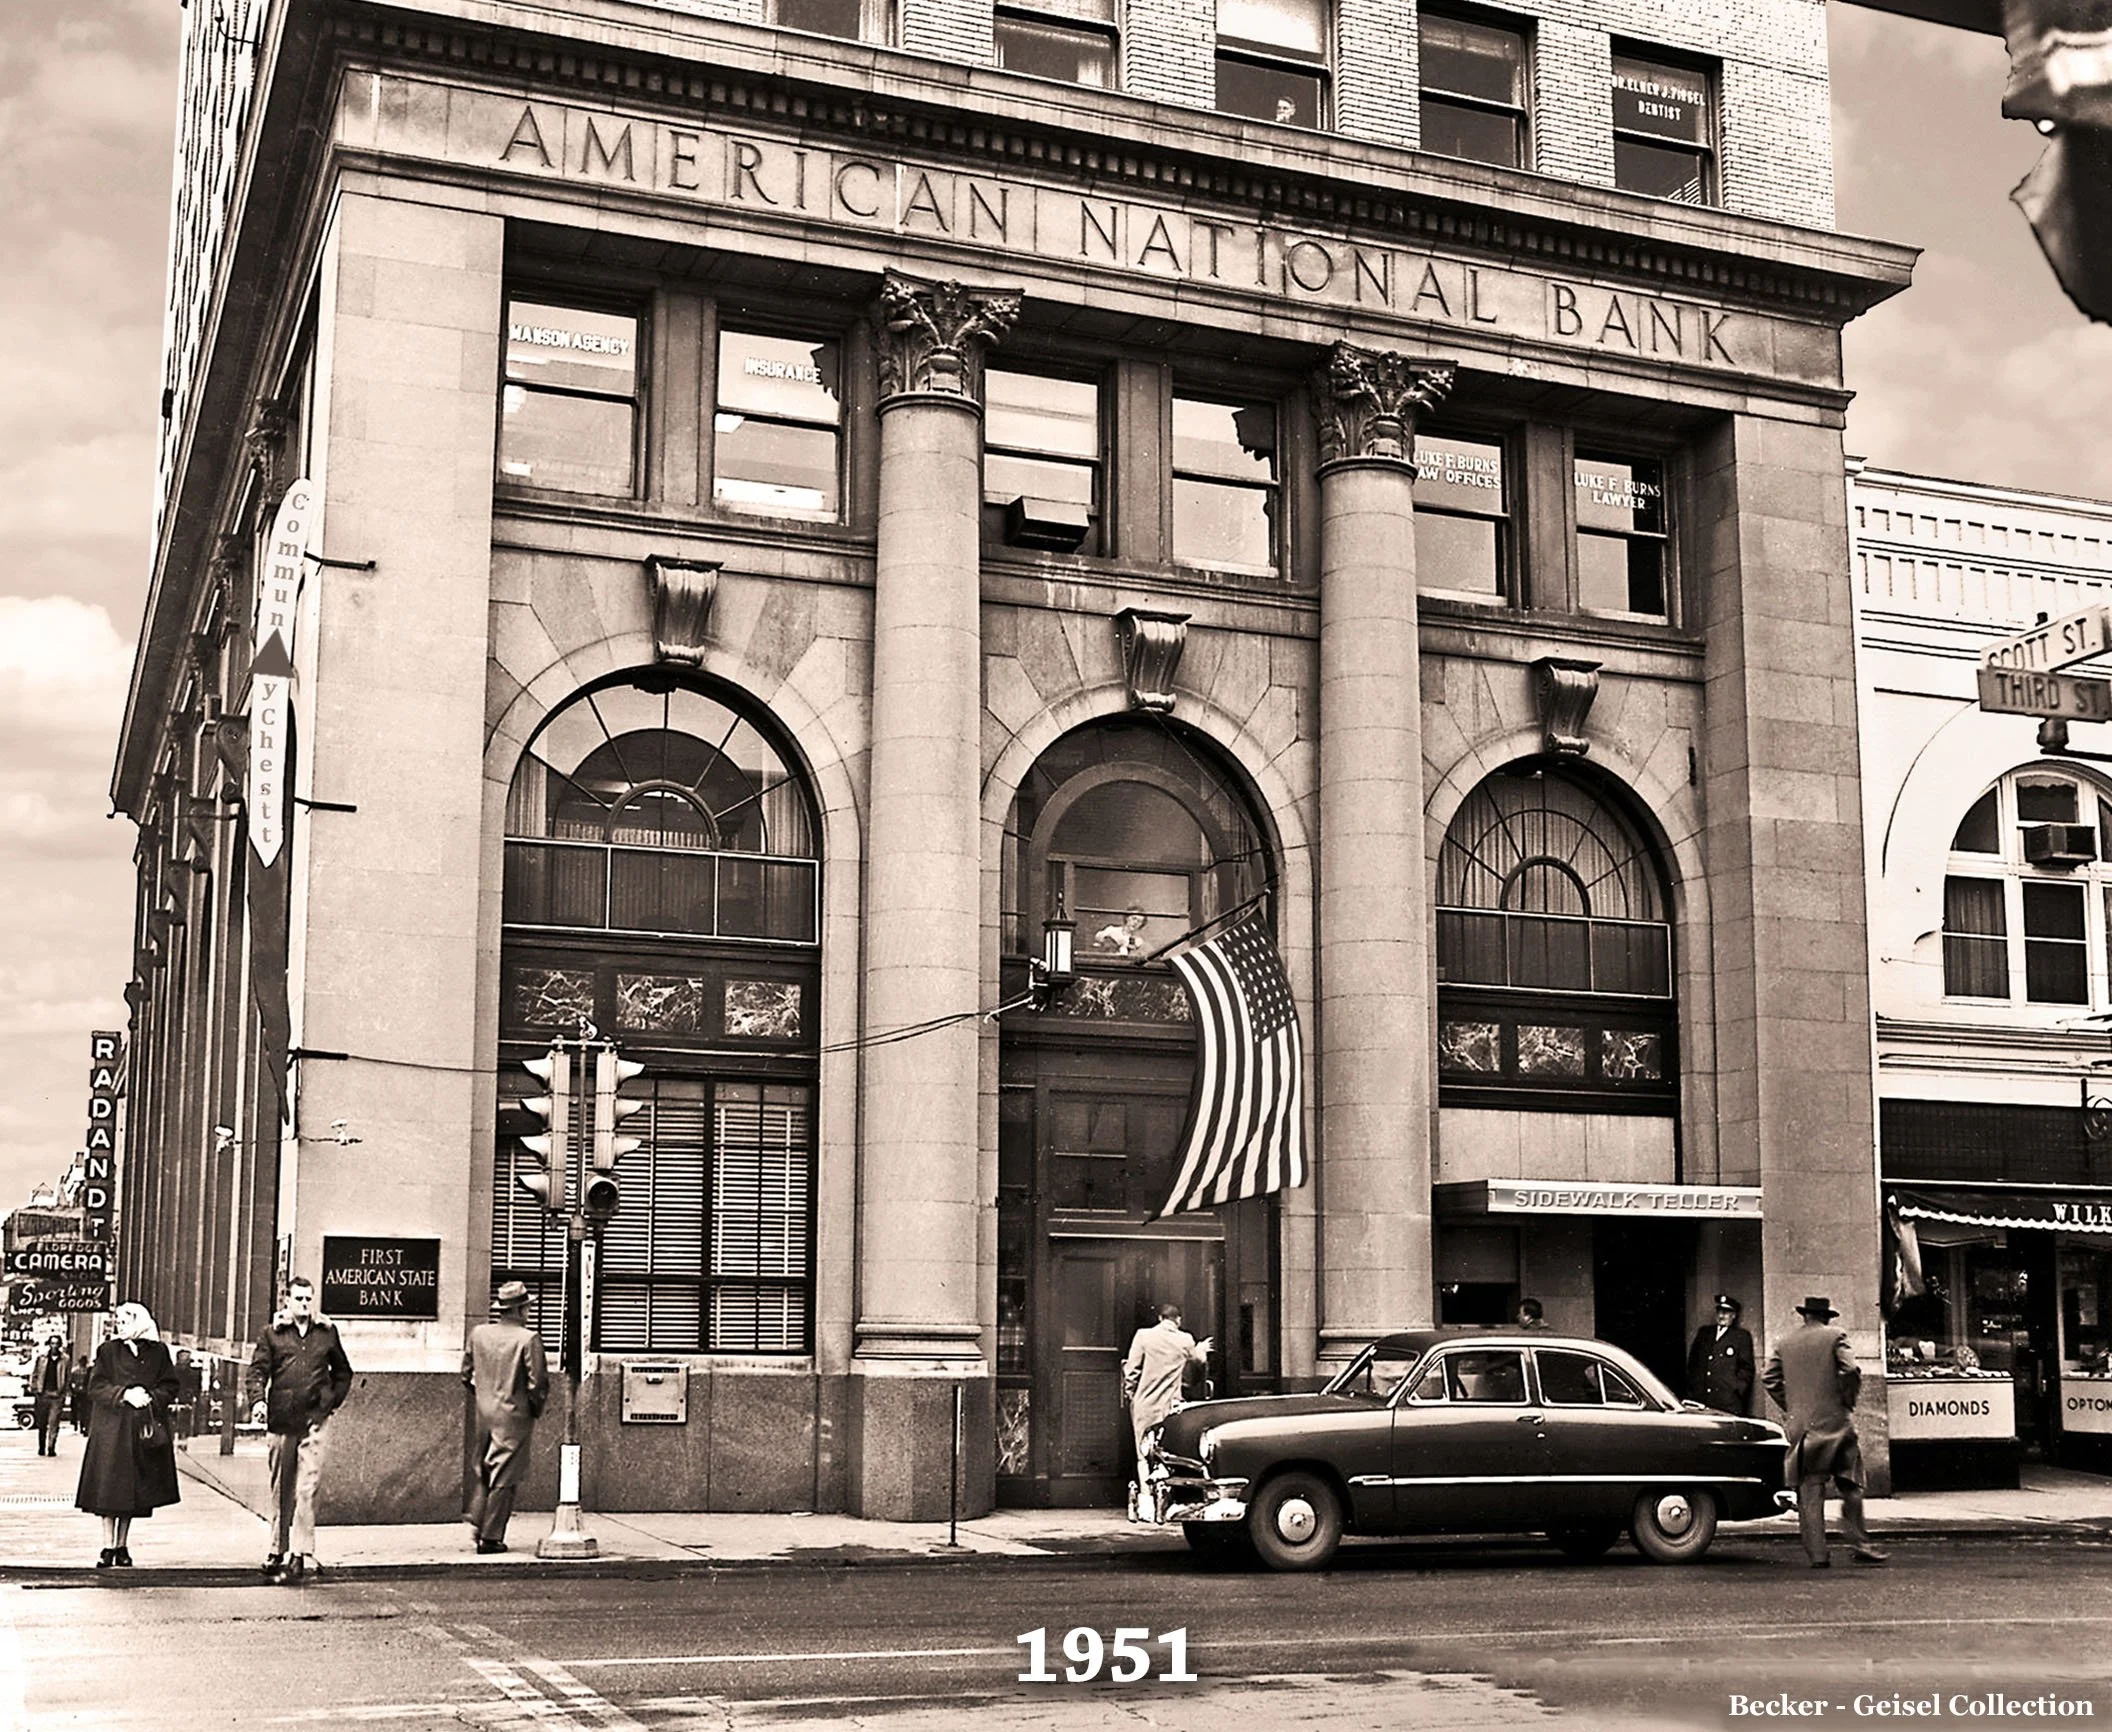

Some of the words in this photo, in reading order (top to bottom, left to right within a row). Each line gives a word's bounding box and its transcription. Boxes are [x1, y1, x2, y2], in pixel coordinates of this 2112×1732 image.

[1638, 100, 1681, 120] DENTIST
[498, 104, 1009, 246] AMERICAN
[1079, 199, 1498, 325] NATIONAL
[1552, 283, 1736, 365] BANK
[571, 332, 629, 356] AGENCY
[744, 356, 822, 384] INSURANCE
[1457, 456, 1498, 474] BURNS
[1445, 469, 1501, 489] OFFICES
[1574, 471, 1604, 490] LUKE
[1624, 479, 1661, 498] BURNS
[1593, 490, 1646, 510] LAWYER
[1995, 672, 2060, 710] THIRD
[1514, 1190, 1641, 1210] SIDEWALK
[1649, 1193, 1740, 1211] TELLER
[14, 1253, 102, 1270] CAMERA
[361, 1248, 404, 1265] FIRST
[325, 1269, 396, 1285] AMERICAN
[399, 1270, 436, 1286] STATE
[19, 1282, 105, 1306] Sporting
[359, 1290, 404, 1306] BANK
[1909, 1400, 1990, 1417] DIAMONDS
